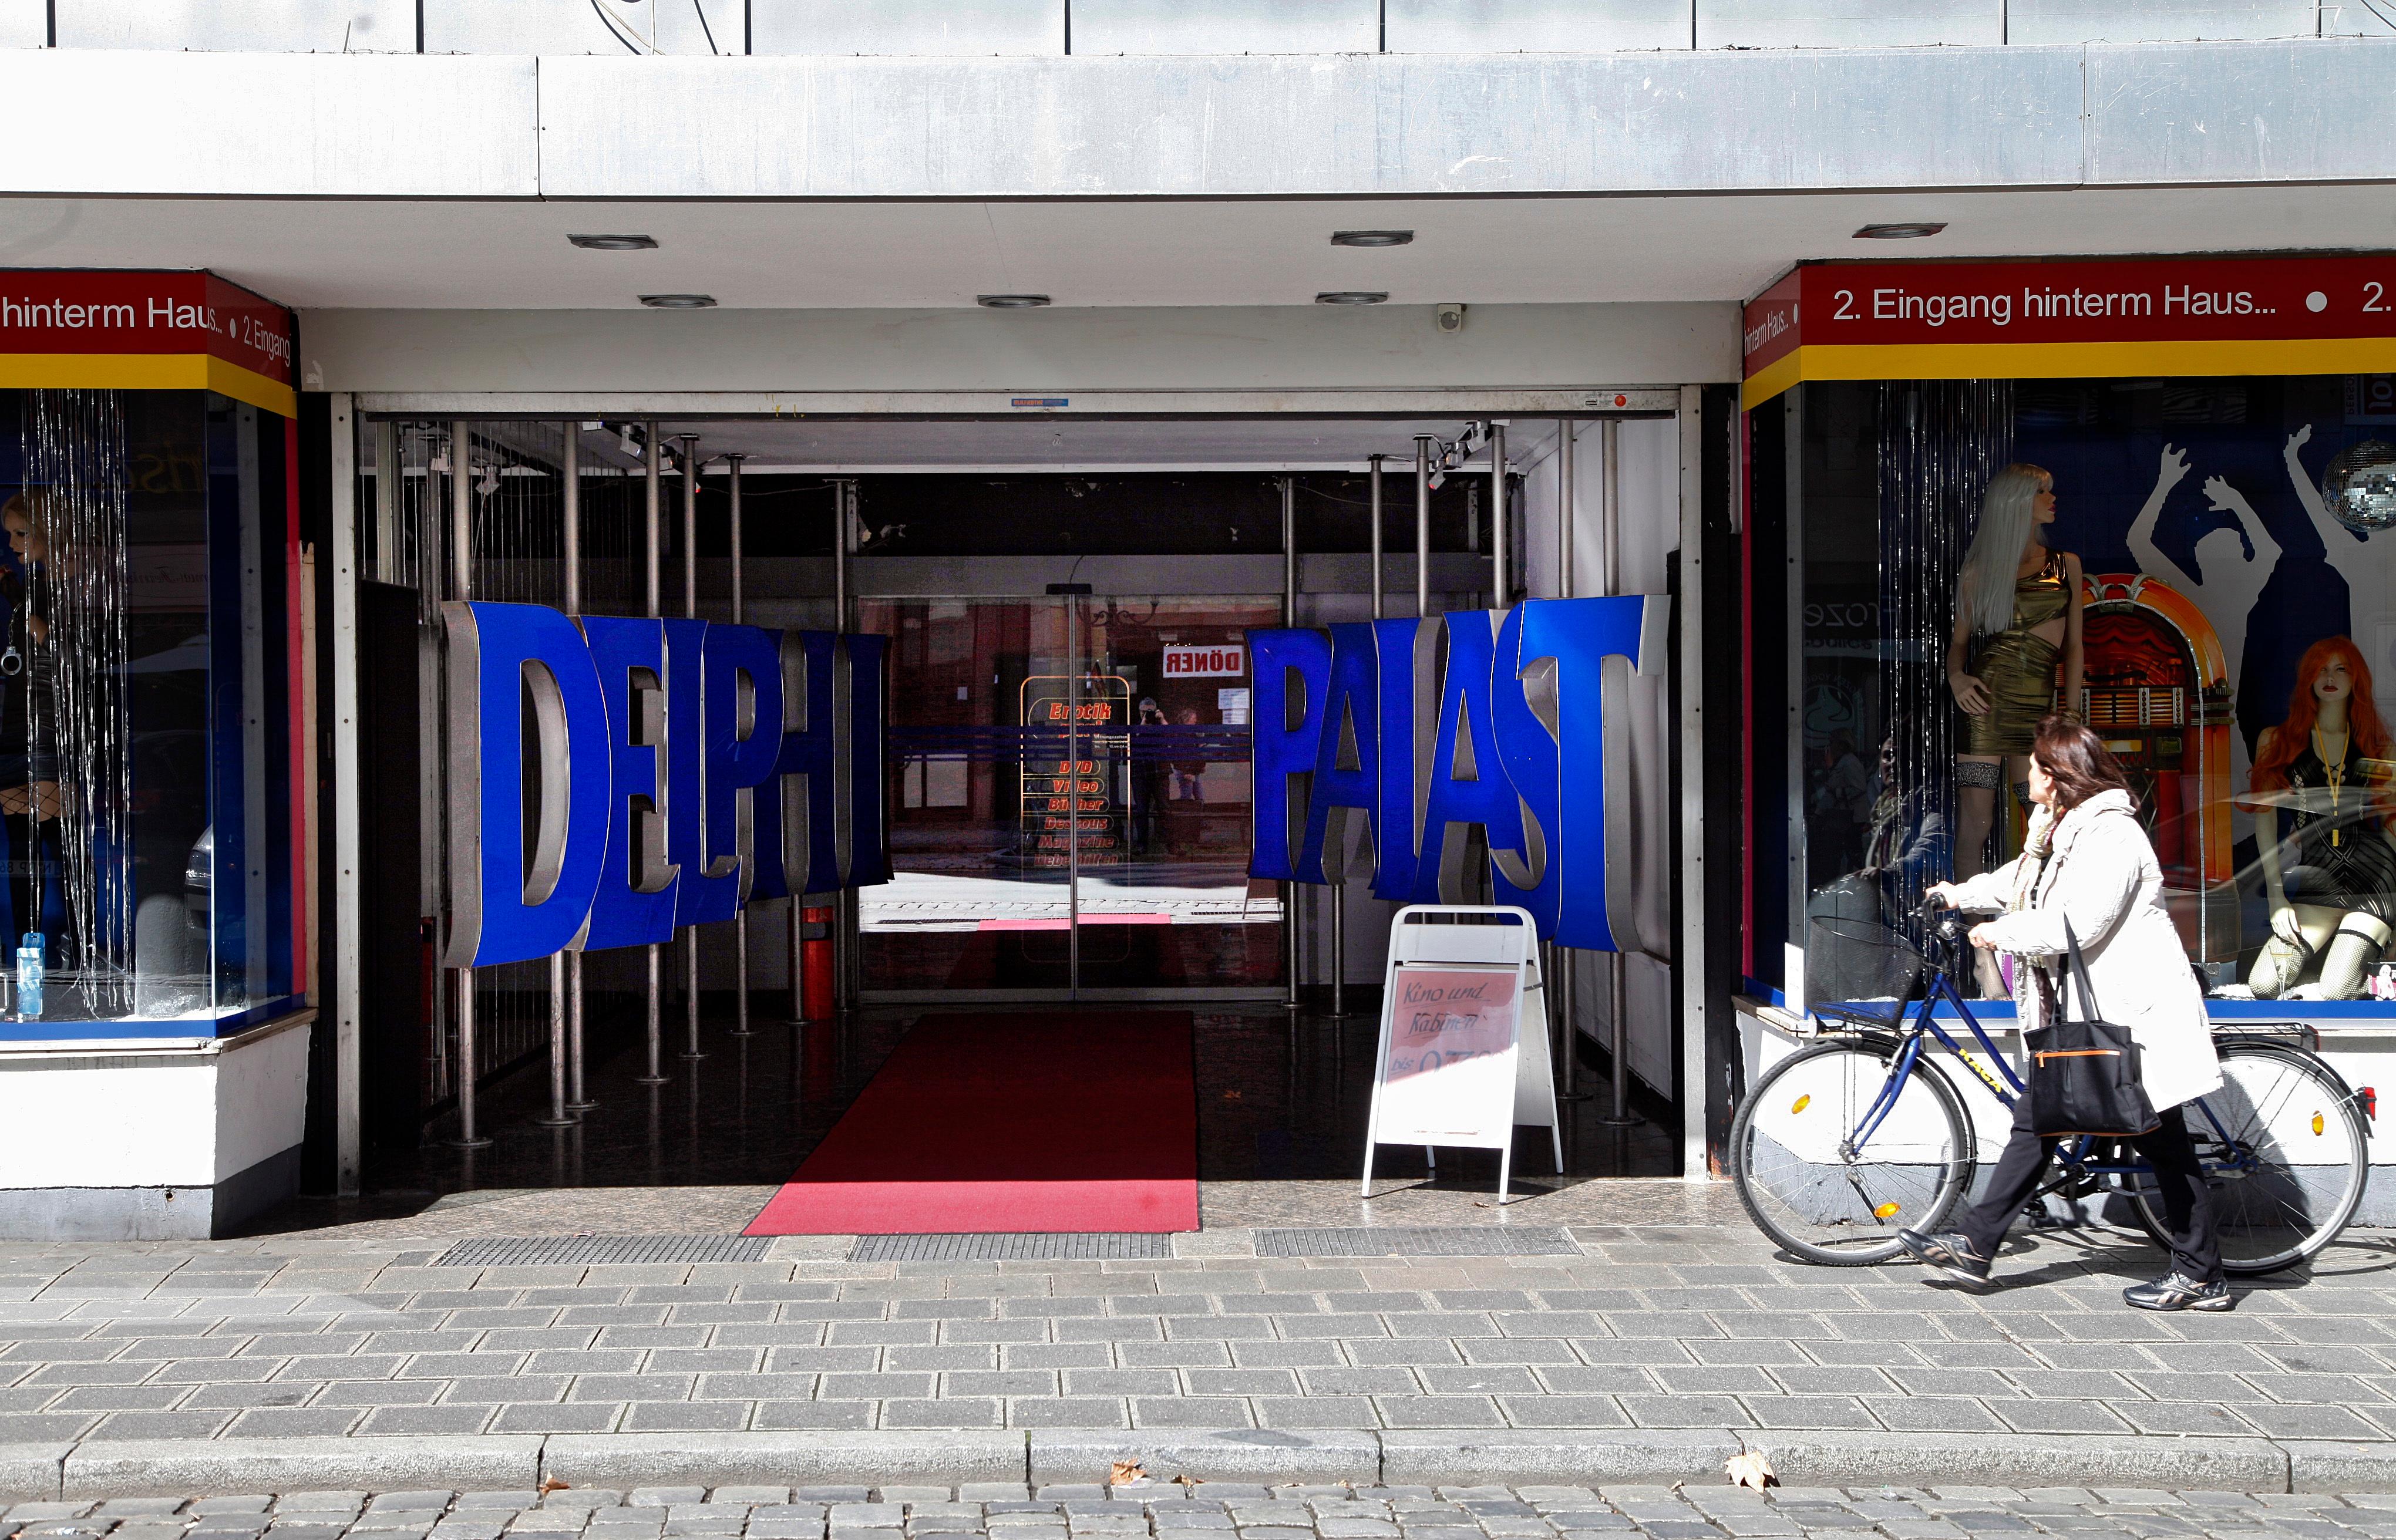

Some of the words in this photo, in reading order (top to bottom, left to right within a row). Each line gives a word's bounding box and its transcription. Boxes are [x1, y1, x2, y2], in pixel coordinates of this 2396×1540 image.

[1833, 290, 1860, 320] 2.
[1874, 288, 2011, 326] Eingang
[2024, 287, 2151, 318] hinterm
[2165, 285, 2276, 315] Haus...
[2362, 282, 2392, 312] 2.
[2, 297, 134, 328] hinterm
[148, 298, 223, 333] Haus...
[244, 315, 252, 346] 2.
[255, 319, 291, 368] Eingang
[1745, 323, 1766, 356] hinterm
[1768, 311, 1789, 341] Haus...
[1049, 703, 1112, 719] Erotik
[464, 600, 890, 969] DELPHI
[1244, 594, 1650, 953] PALAST
[1048, 798, 1104, 811] Büher
[1403, 982, 1444, 1004] Kino
[1448, 982, 1489, 1000] und
[1408, 1012, 1479, 1035] Kabinen
[1391, 1057, 1415, 1071] bis
